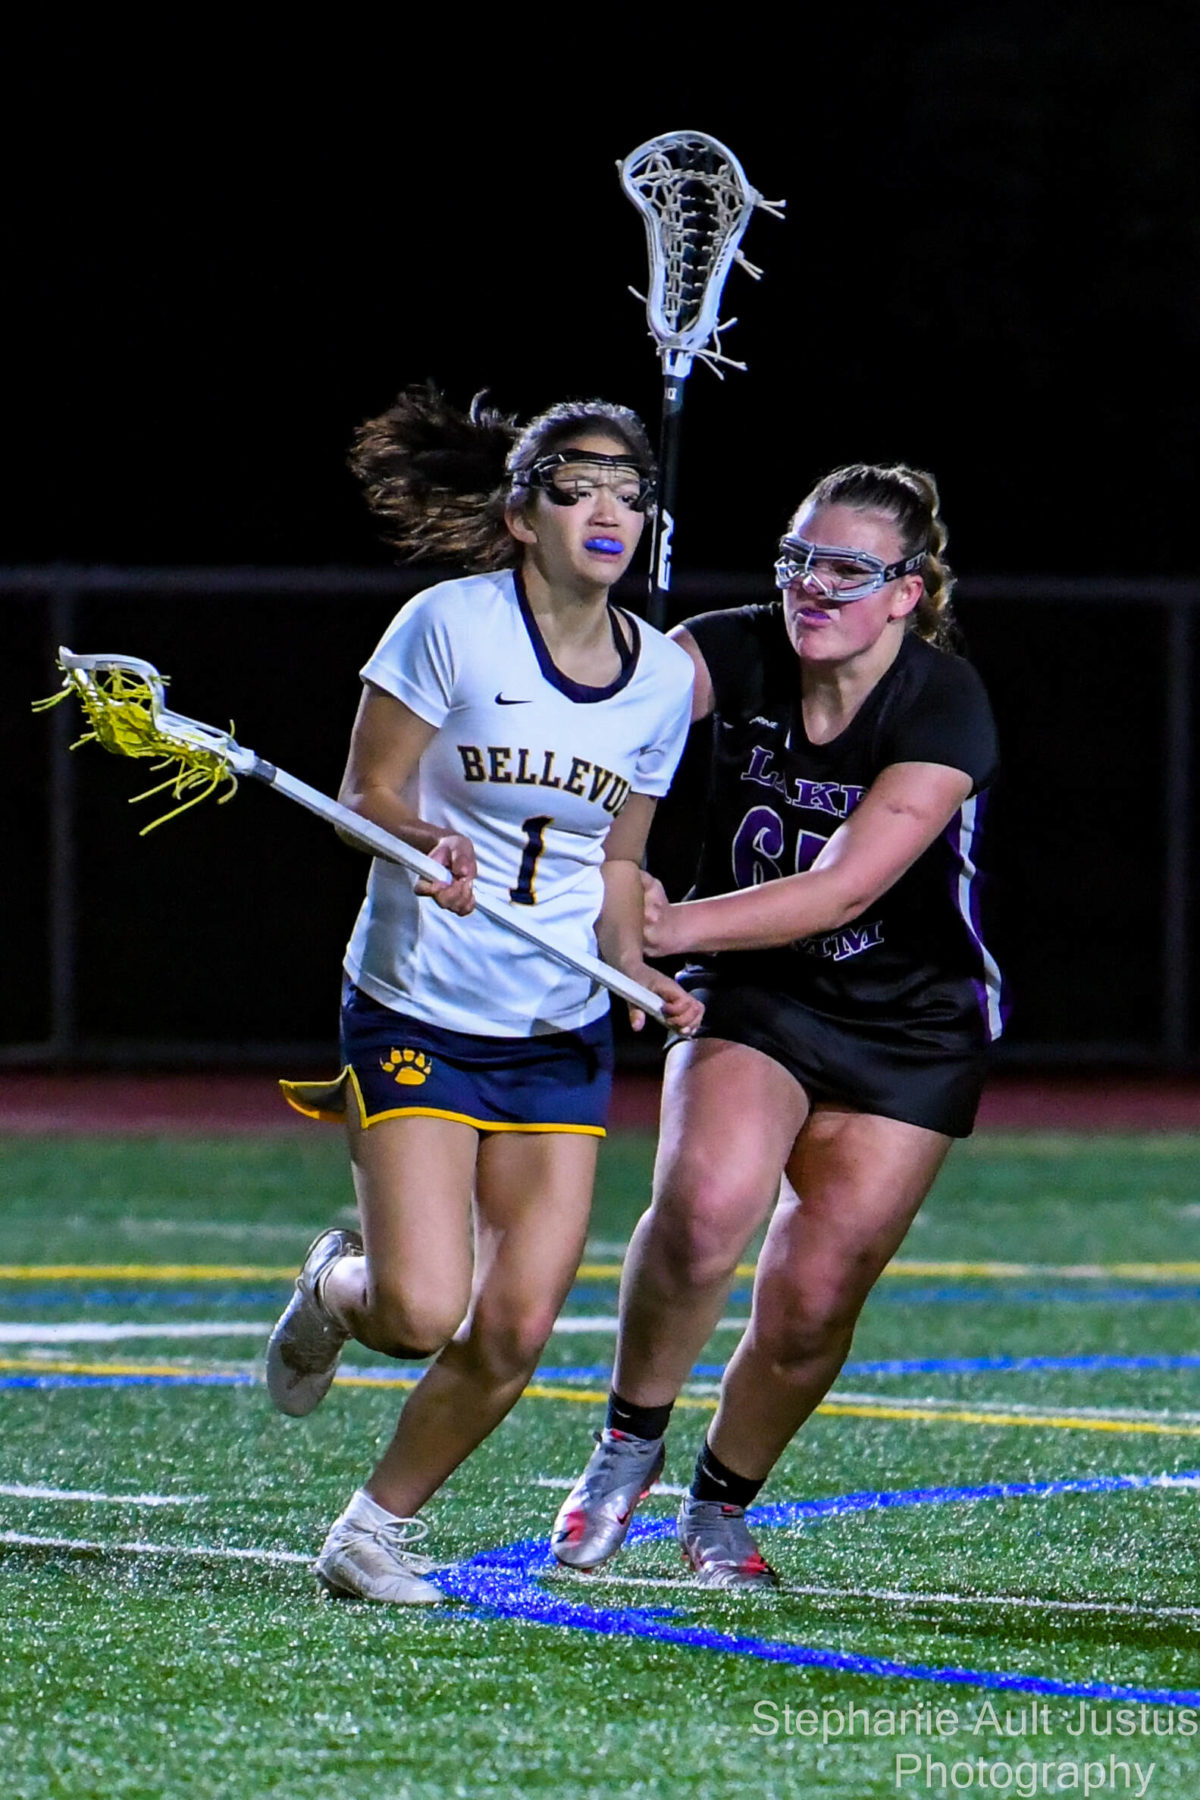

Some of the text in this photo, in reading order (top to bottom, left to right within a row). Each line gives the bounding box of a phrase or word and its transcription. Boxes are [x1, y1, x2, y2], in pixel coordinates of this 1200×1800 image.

[457, 745, 632, 818] BELLEVU
[509, 815, 555, 906] 1
[731, 804, 830, 888] 6
